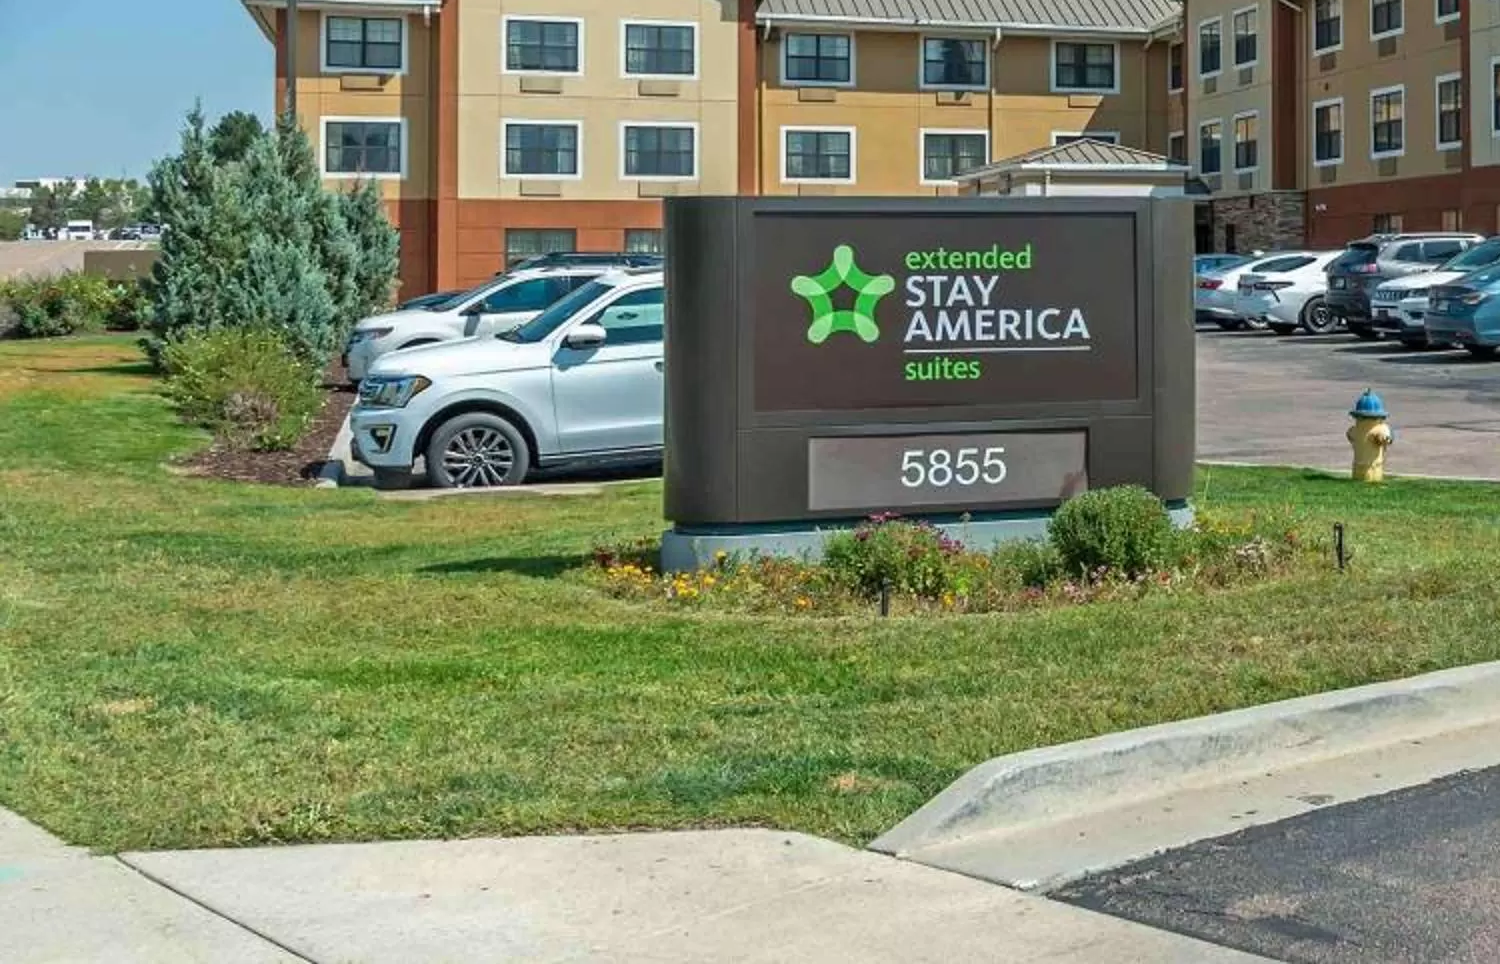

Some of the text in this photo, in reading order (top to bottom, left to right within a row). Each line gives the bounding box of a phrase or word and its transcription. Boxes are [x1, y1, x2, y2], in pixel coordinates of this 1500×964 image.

[905, 244, 1031, 270] extended
[905, 275, 999, 307] STAY
[903, 308, 1091, 342] AMERICA
[904, 356, 981, 381] suites
[901, 447, 1007, 488] 5855
